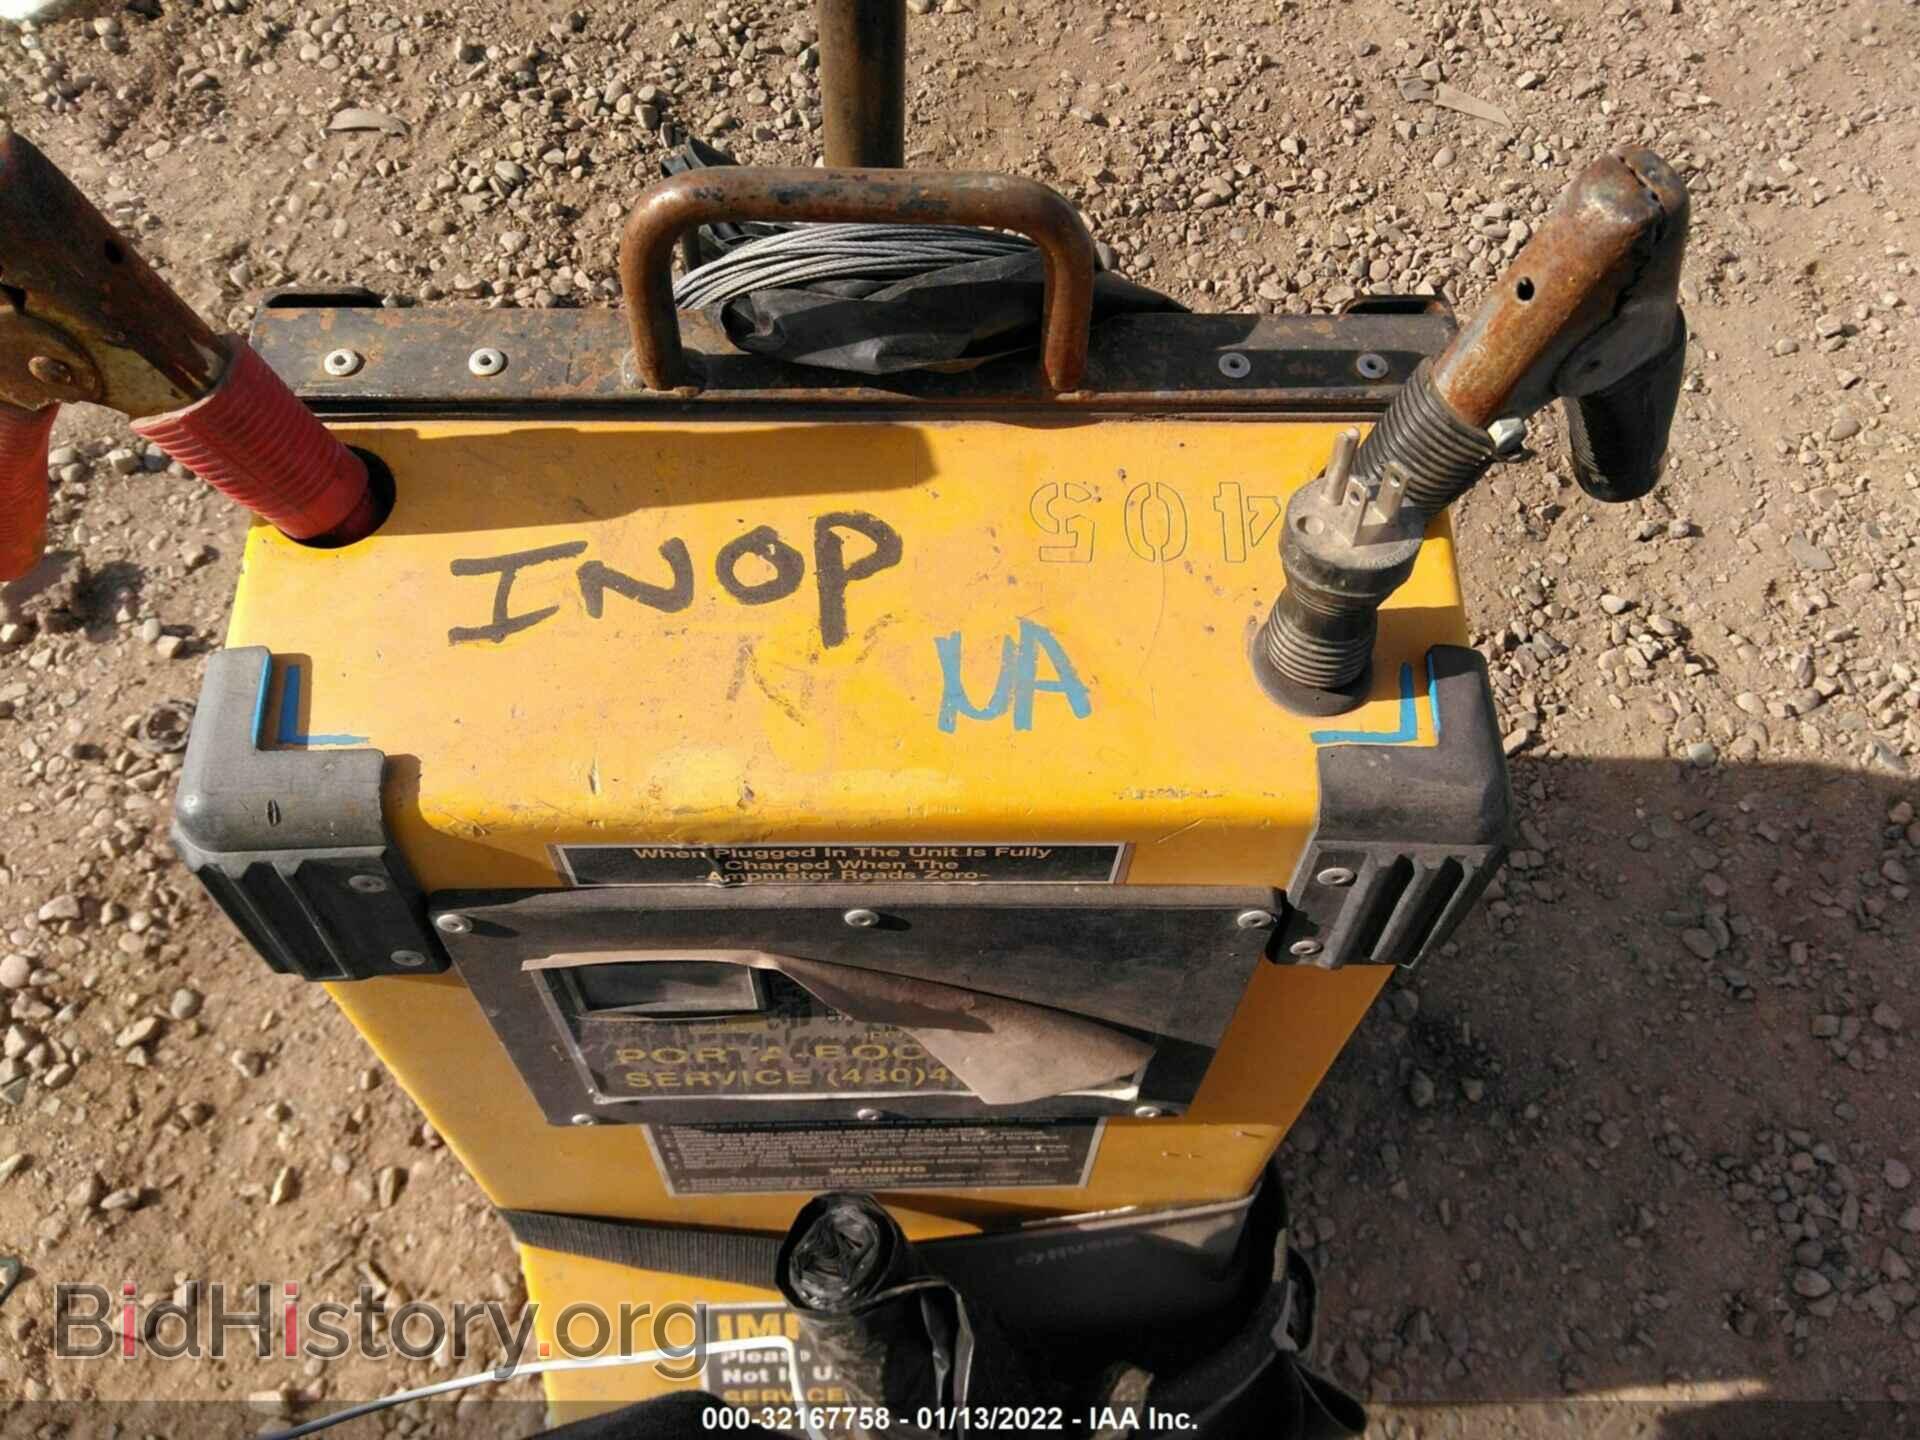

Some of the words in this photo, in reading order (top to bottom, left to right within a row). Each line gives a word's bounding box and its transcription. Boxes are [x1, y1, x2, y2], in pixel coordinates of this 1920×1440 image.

[448, 510, 904, 648] INOP
[634, 847, 706, 859] When
[714, 847, 816, 860] Plugged
[824, 847, 848, 858] In
[854, 847, 900, 858] The
[908, 847, 957, 858] Unit
[966, 847, 987, 858] Is
[996, 847, 1053, 861] Fully
[724, 860, 830, 872] Charged
[837, 859, 906, 870] When
[914, 859, 960, 870] The
[625, 1068, 811, 1088] SERVICE
[721, 1368, 770, 1384] Not
[723, 1386, 846, 1405] SERVCE
